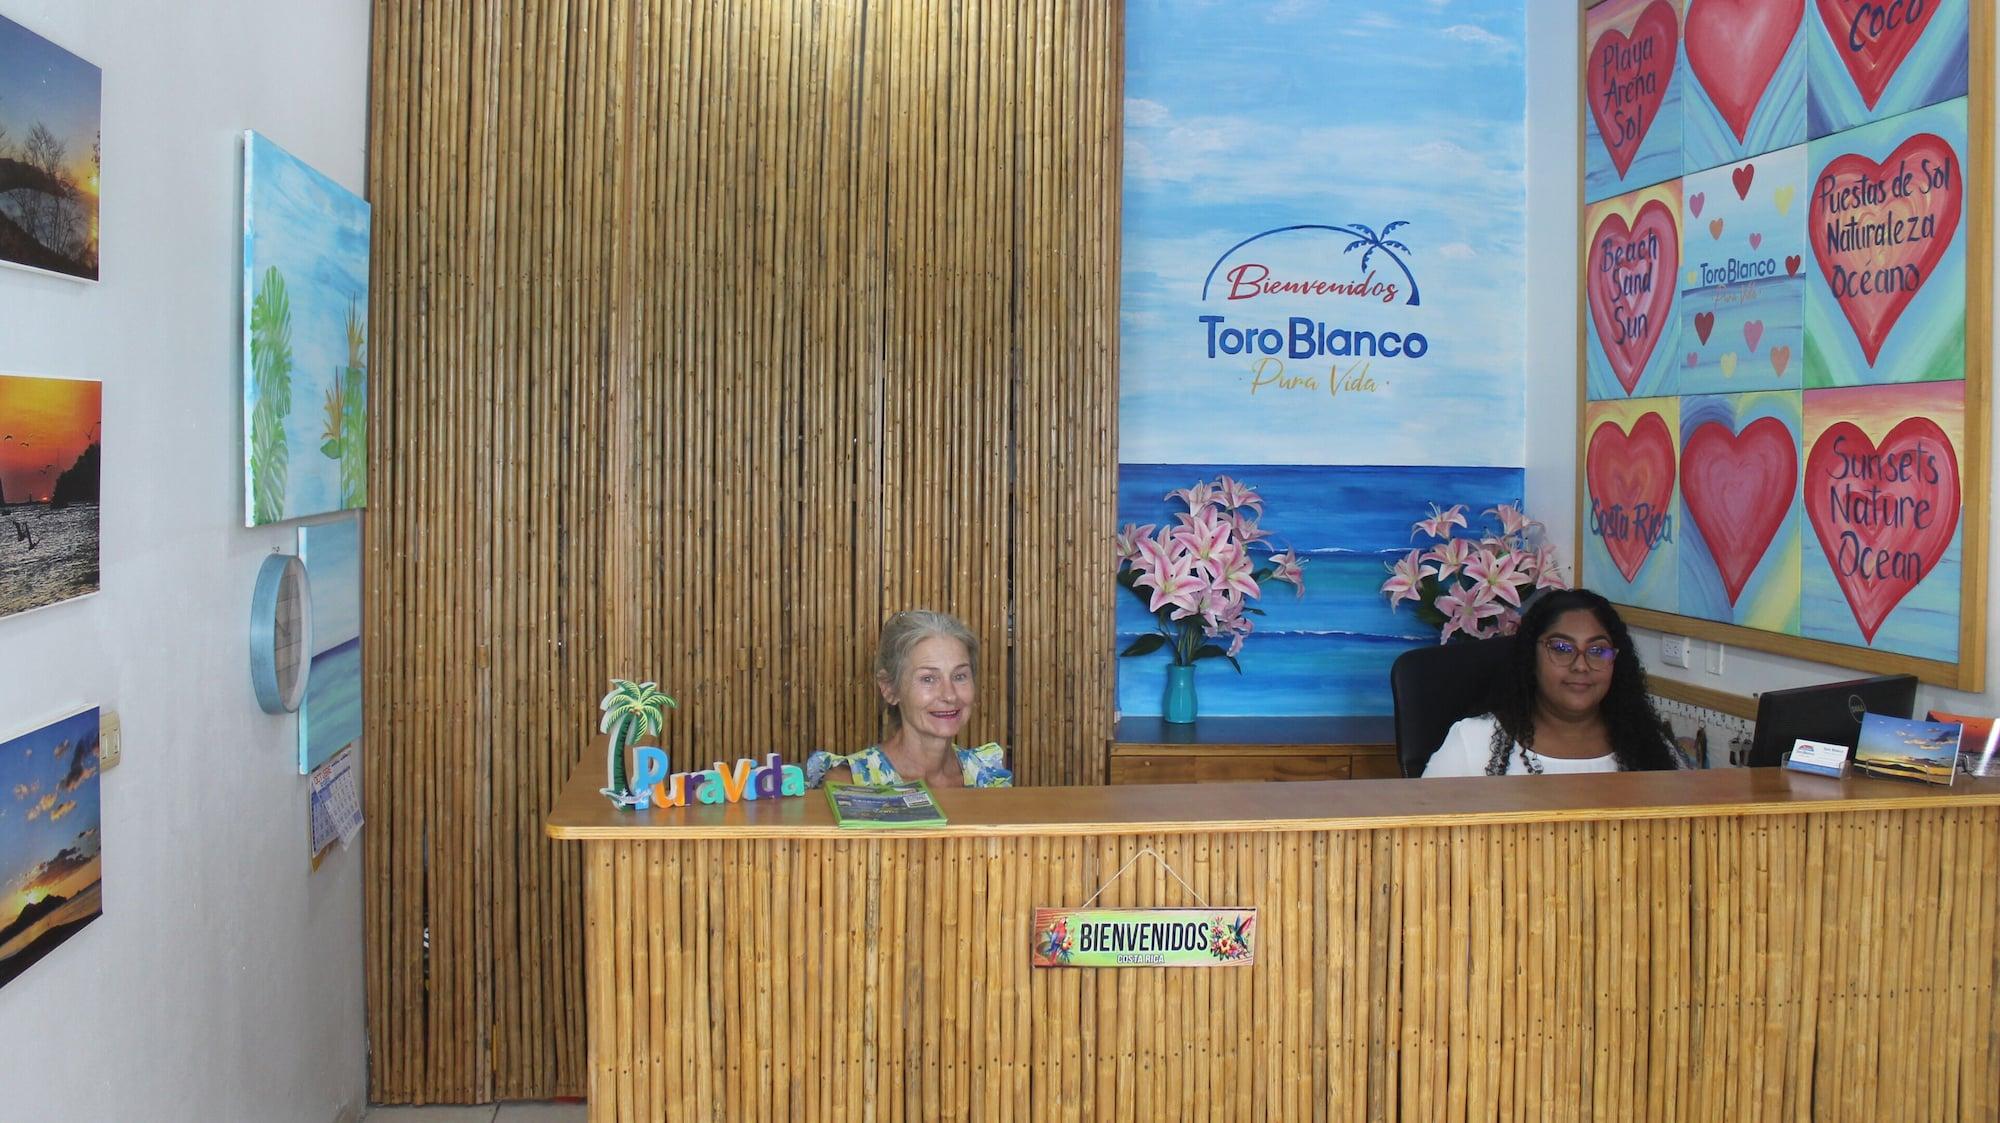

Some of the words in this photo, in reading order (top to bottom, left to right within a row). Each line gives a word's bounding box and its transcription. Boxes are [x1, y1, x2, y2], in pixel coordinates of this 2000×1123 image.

[1602, 36, 1654, 85] Playa
[1603, 71, 1656, 114] Arena
[1613, 103, 1643, 147] Sol
[1818, 173, 1887, 215] Puestas
[1891, 160, 1914, 198] de
[1919, 157, 1951, 195] Sol
[1600, 227, 1658, 272] Beach
[1826, 210, 1935, 256] Naturaleza
[1226, 263, 1399, 303] Bienvenidos
[1611, 262, 1653, 303] Sand
[1831, 260, 1921, 299] Océano
[1613, 306, 1649, 345] Sun
[1251, 357, 1320, 396] Pura
[1329, 360, 1378, 397] Vida
[1826, 435, 1939, 485] Sunsets
[1591, 497, 1629, 542] Costa
[1632, 503, 1673, 551] Rica
[1830, 483, 1935, 530] Nature
[1838, 530, 1922, 585] Ocean
[1080, 922, 1209, 952] BIENVENIDOS
[1117, 953, 1143, 964] COSTA
[1145, 953, 1165, 964] RICA
